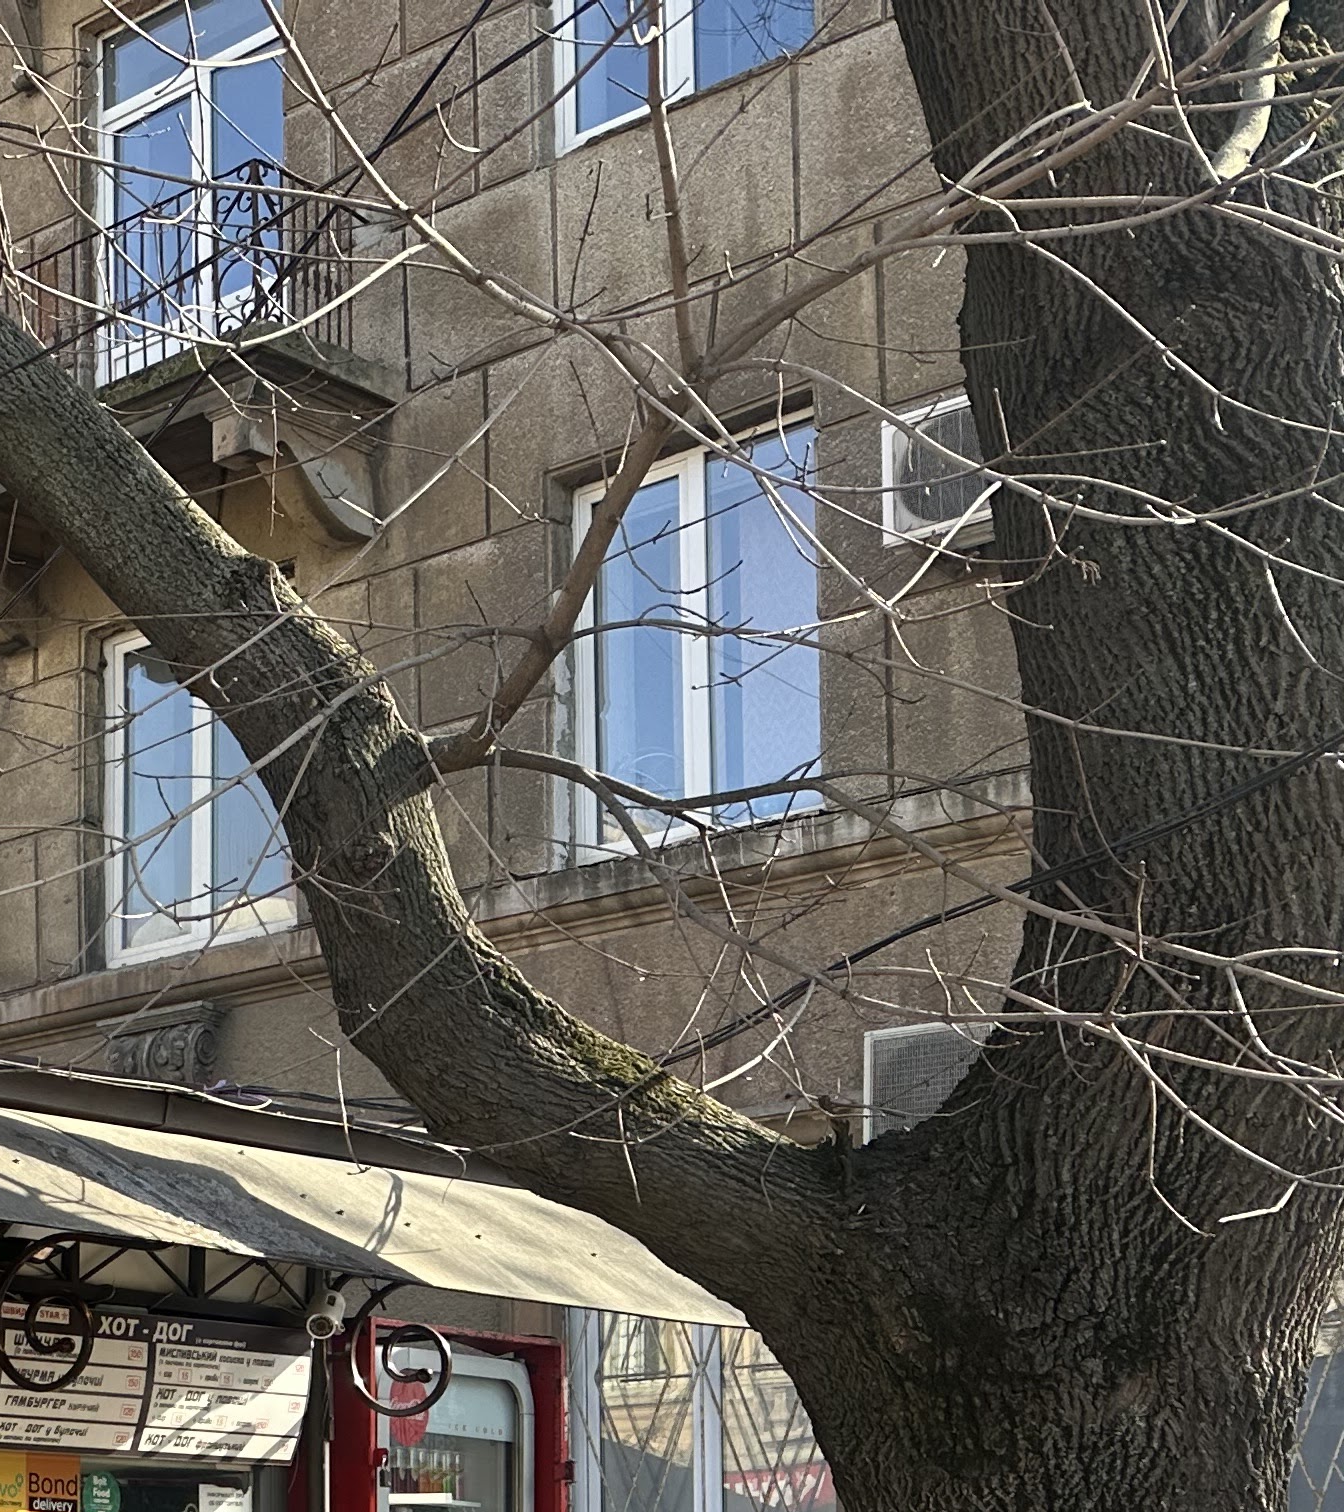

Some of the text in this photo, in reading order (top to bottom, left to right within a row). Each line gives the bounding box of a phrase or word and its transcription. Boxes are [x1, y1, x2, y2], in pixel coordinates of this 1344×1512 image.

[97, 1316, 136, 1338] ХОТ
[151, 1321, 194, 1343] ДОГ
[5, 1394, 66, 1411] ГАМБУРГЕР
[29, 1473, 78, 1496] Bond
